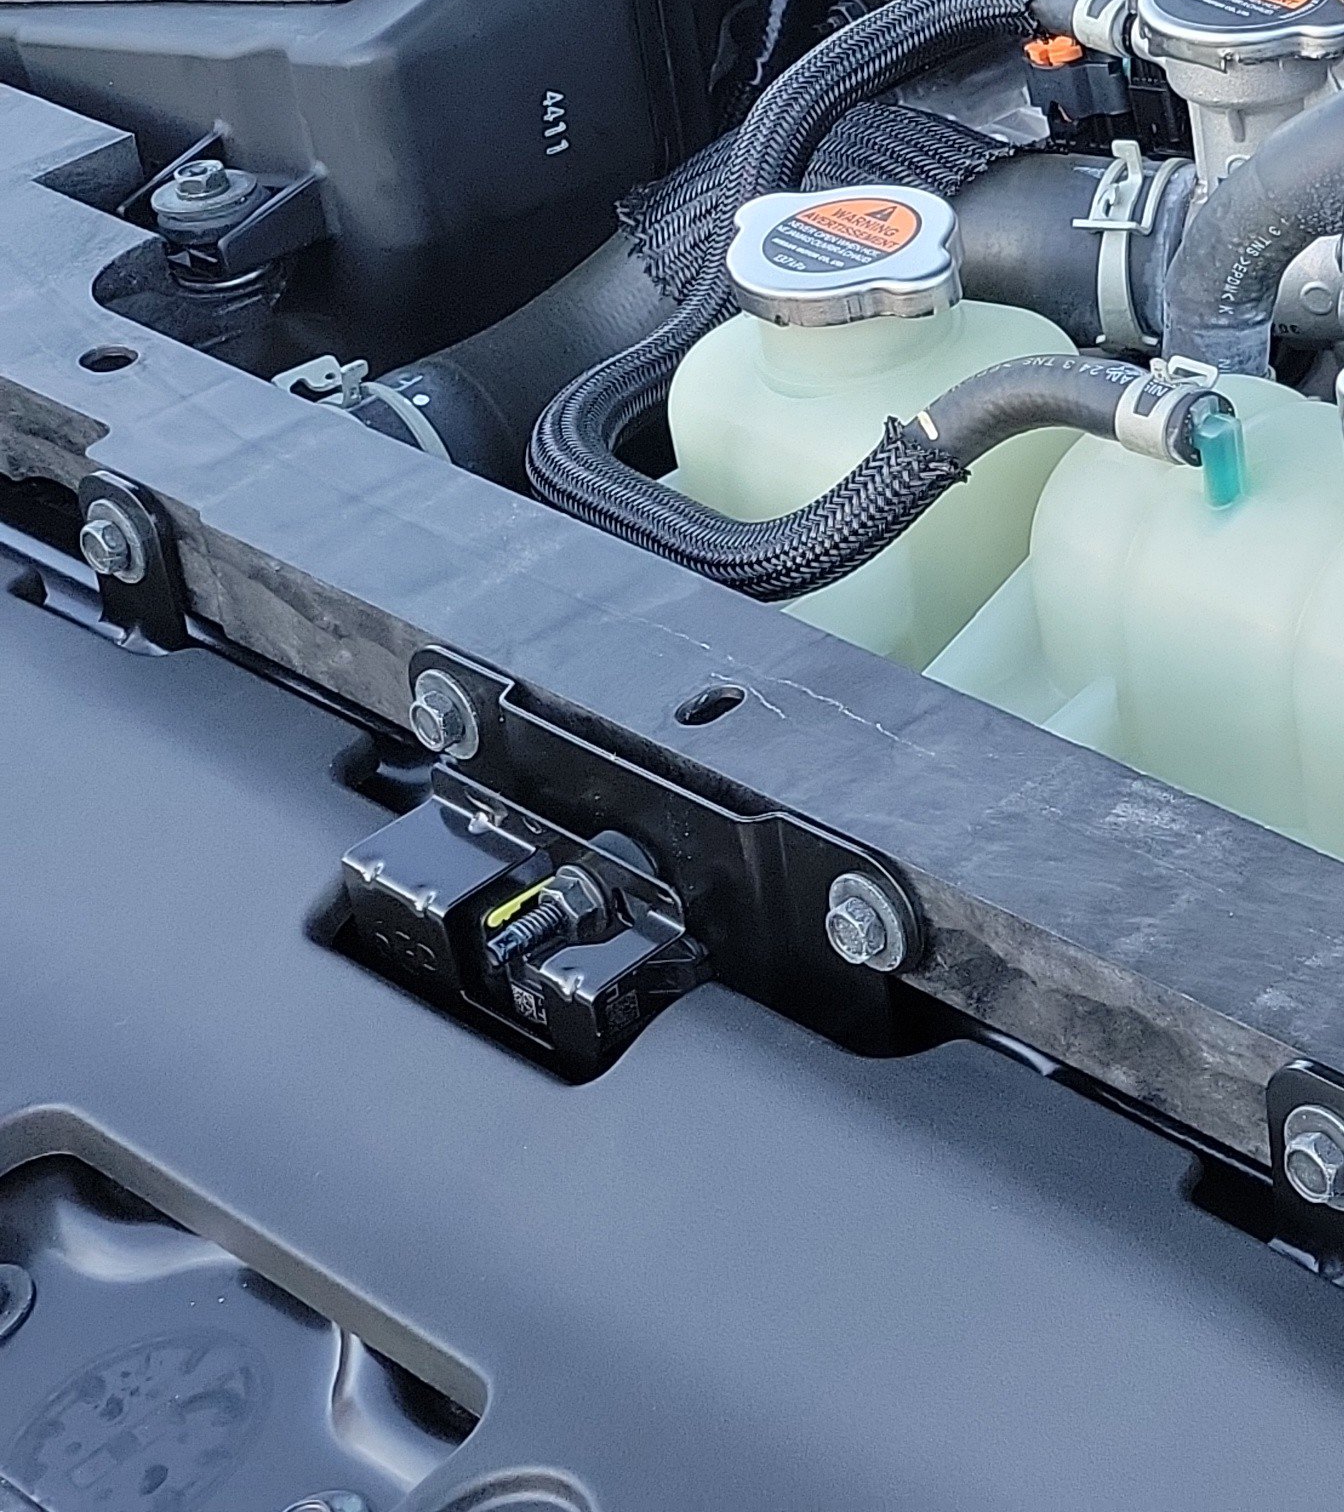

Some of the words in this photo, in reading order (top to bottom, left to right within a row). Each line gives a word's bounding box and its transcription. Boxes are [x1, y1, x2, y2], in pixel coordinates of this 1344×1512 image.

[543, 91, 569, 155] 4411
[803, 212, 900, 249] AVERTISSEMENT
[831, 208, 899, 237] WARNING
